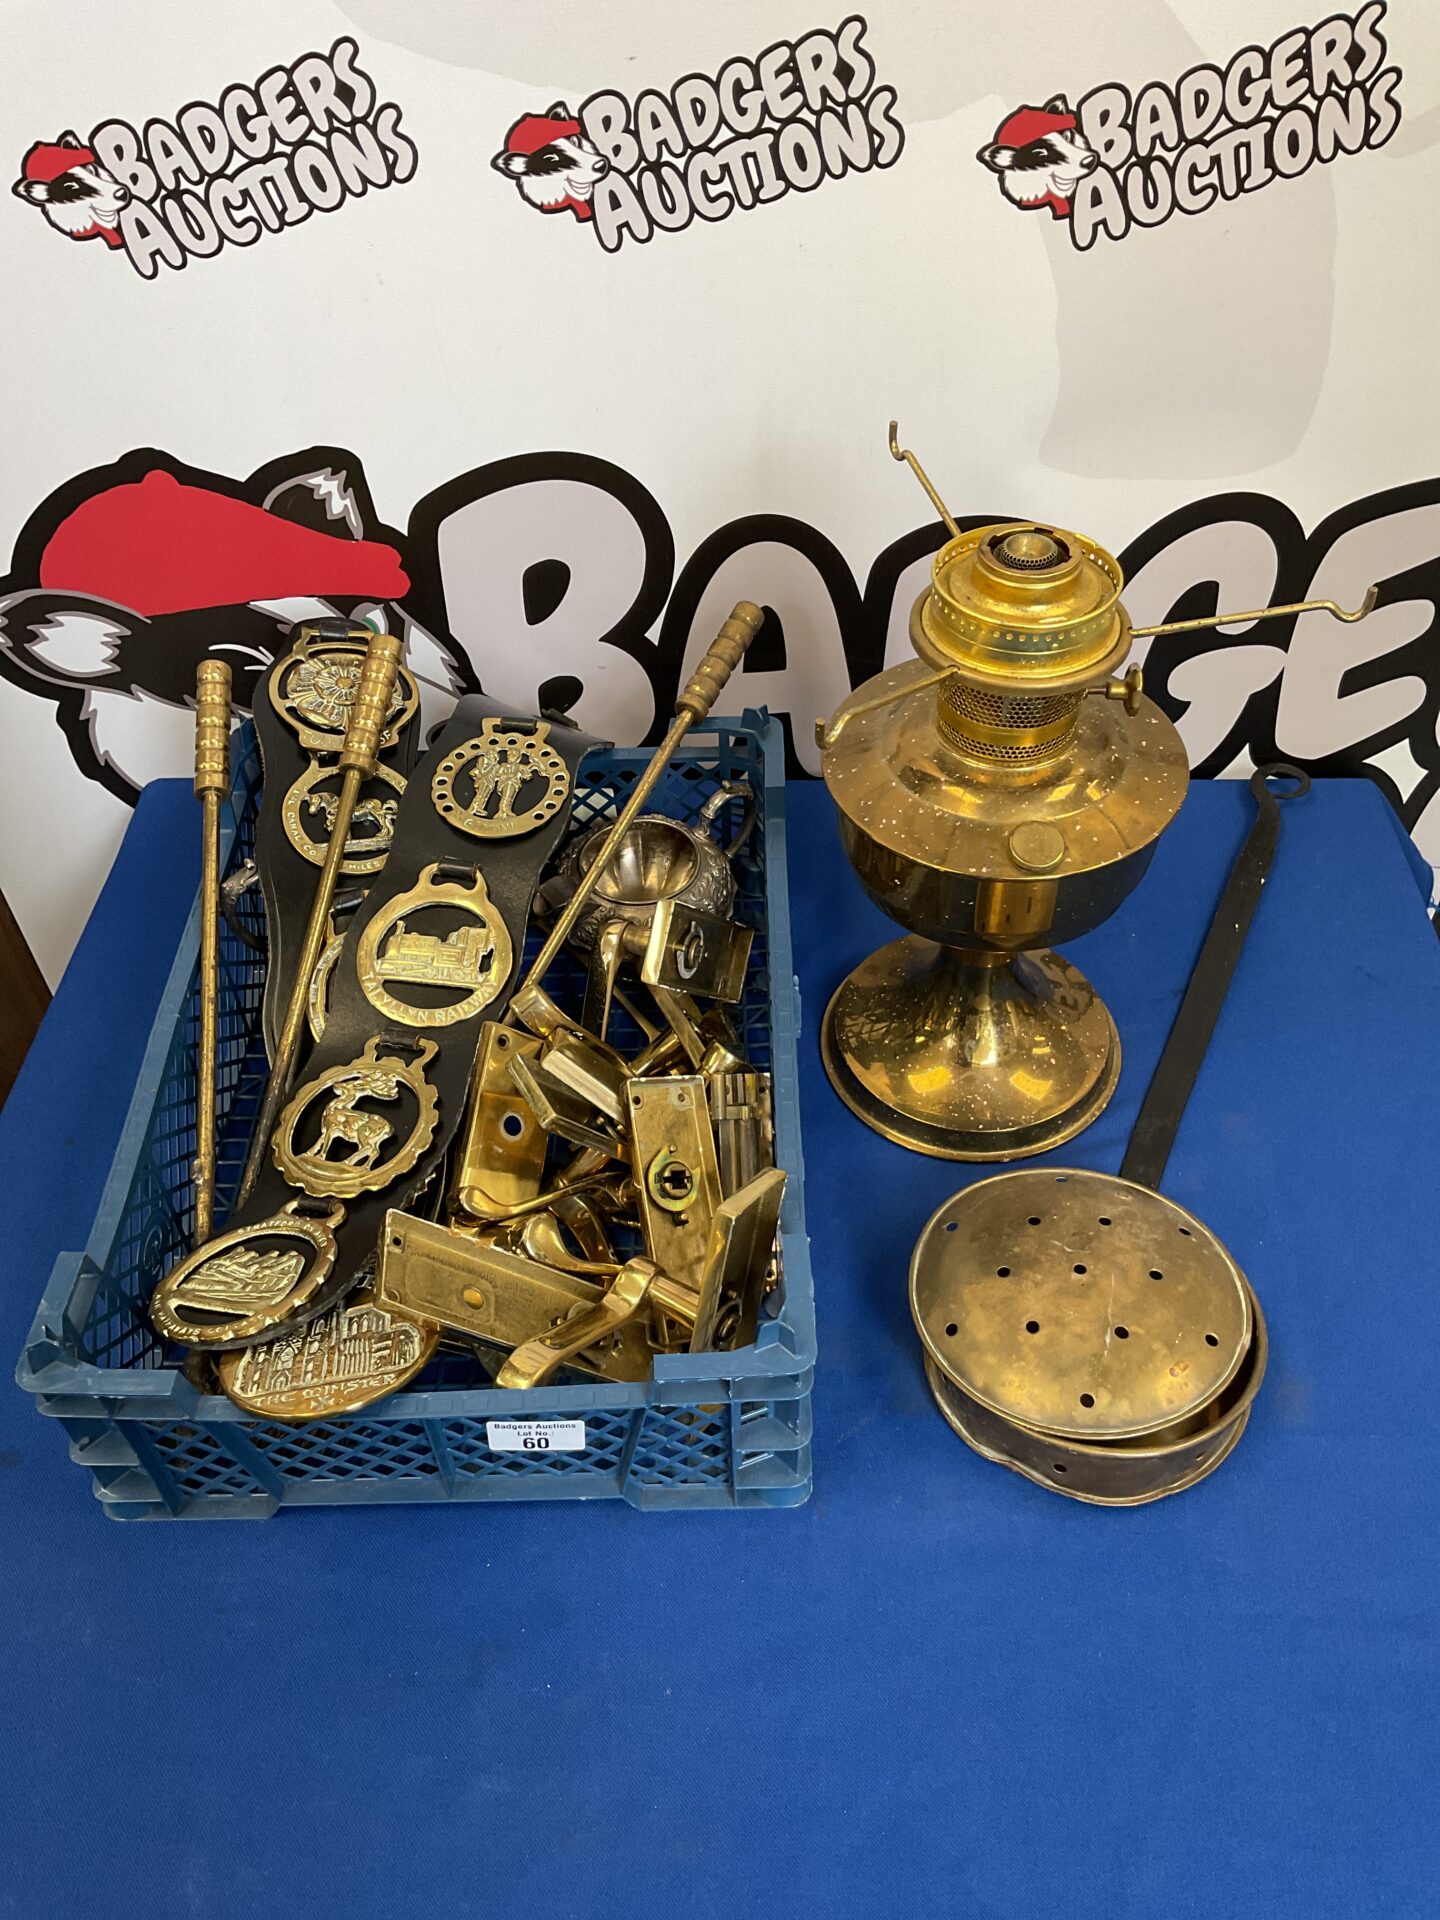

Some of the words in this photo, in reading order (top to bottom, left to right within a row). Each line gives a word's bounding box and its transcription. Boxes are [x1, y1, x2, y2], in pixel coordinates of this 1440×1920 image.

[88, 36, 376, 202] BADGERS
[578, 15, 876, 174] BADGERS
[591, 84, 905, 253] AUCTIONS
[1069, 66, 1402, 251] AUCTIONS
[1077, 0, 1389, 172] BADGERS
[121, 101, 418, 280] AUCTIONS
[522, 1437, 550, 1450] 60
